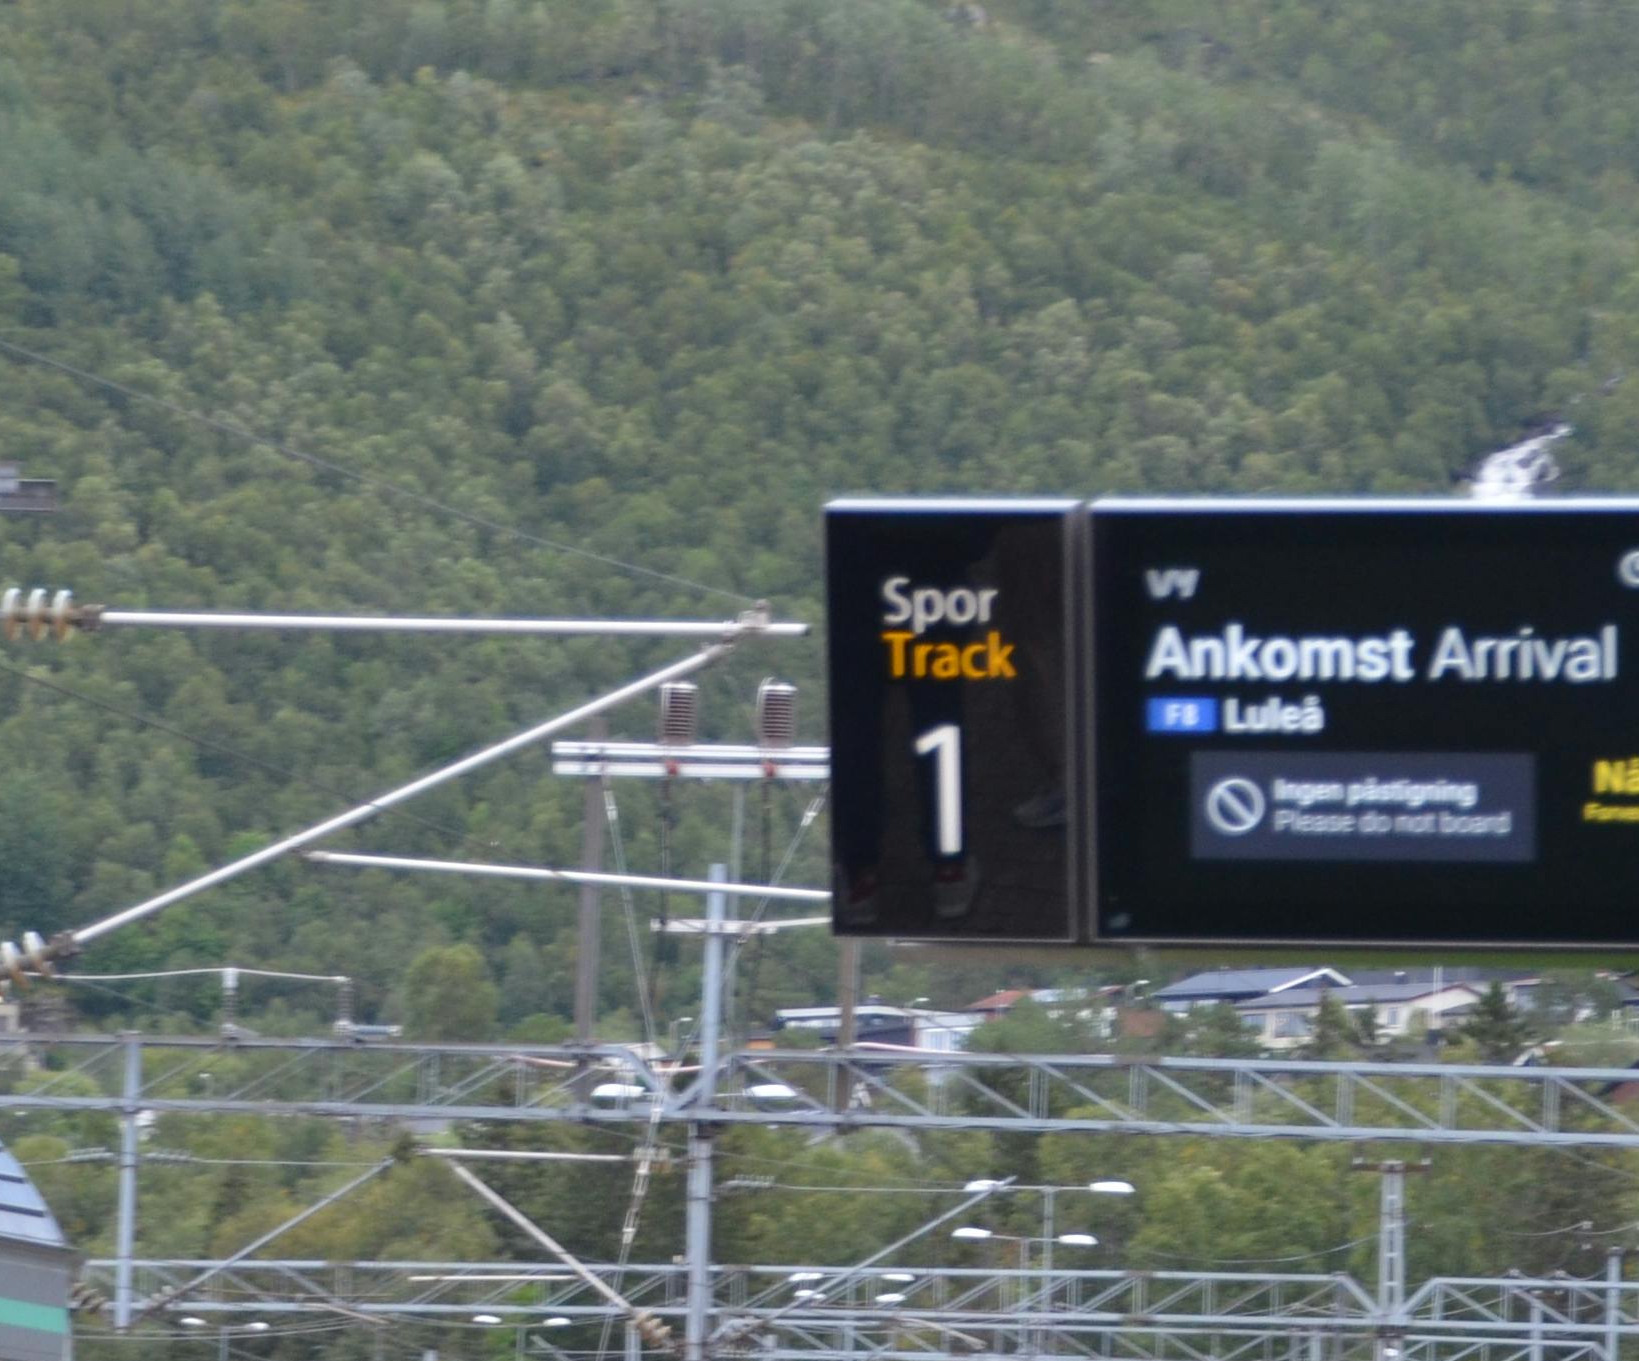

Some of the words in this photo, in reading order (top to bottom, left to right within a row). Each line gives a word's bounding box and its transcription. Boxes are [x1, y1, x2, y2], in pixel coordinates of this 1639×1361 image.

[882, 576, 998, 634] Spor
[880, 630, 1017, 679] Track
[1145, 623, 1414, 682] Ankomst
[1427, 623, 1617, 682] Arrival
[1224, 694, 1324, 734] Luleå
[915, 723, 961, 856] 1
[1273, 779, 1344, 807] Ingen
[1273, 809, 1356, 833] Please
[1360, 811, 1393, 833] do
[1394, 811, 1437, 833] not
[1439, 811, 1512, 834] board
